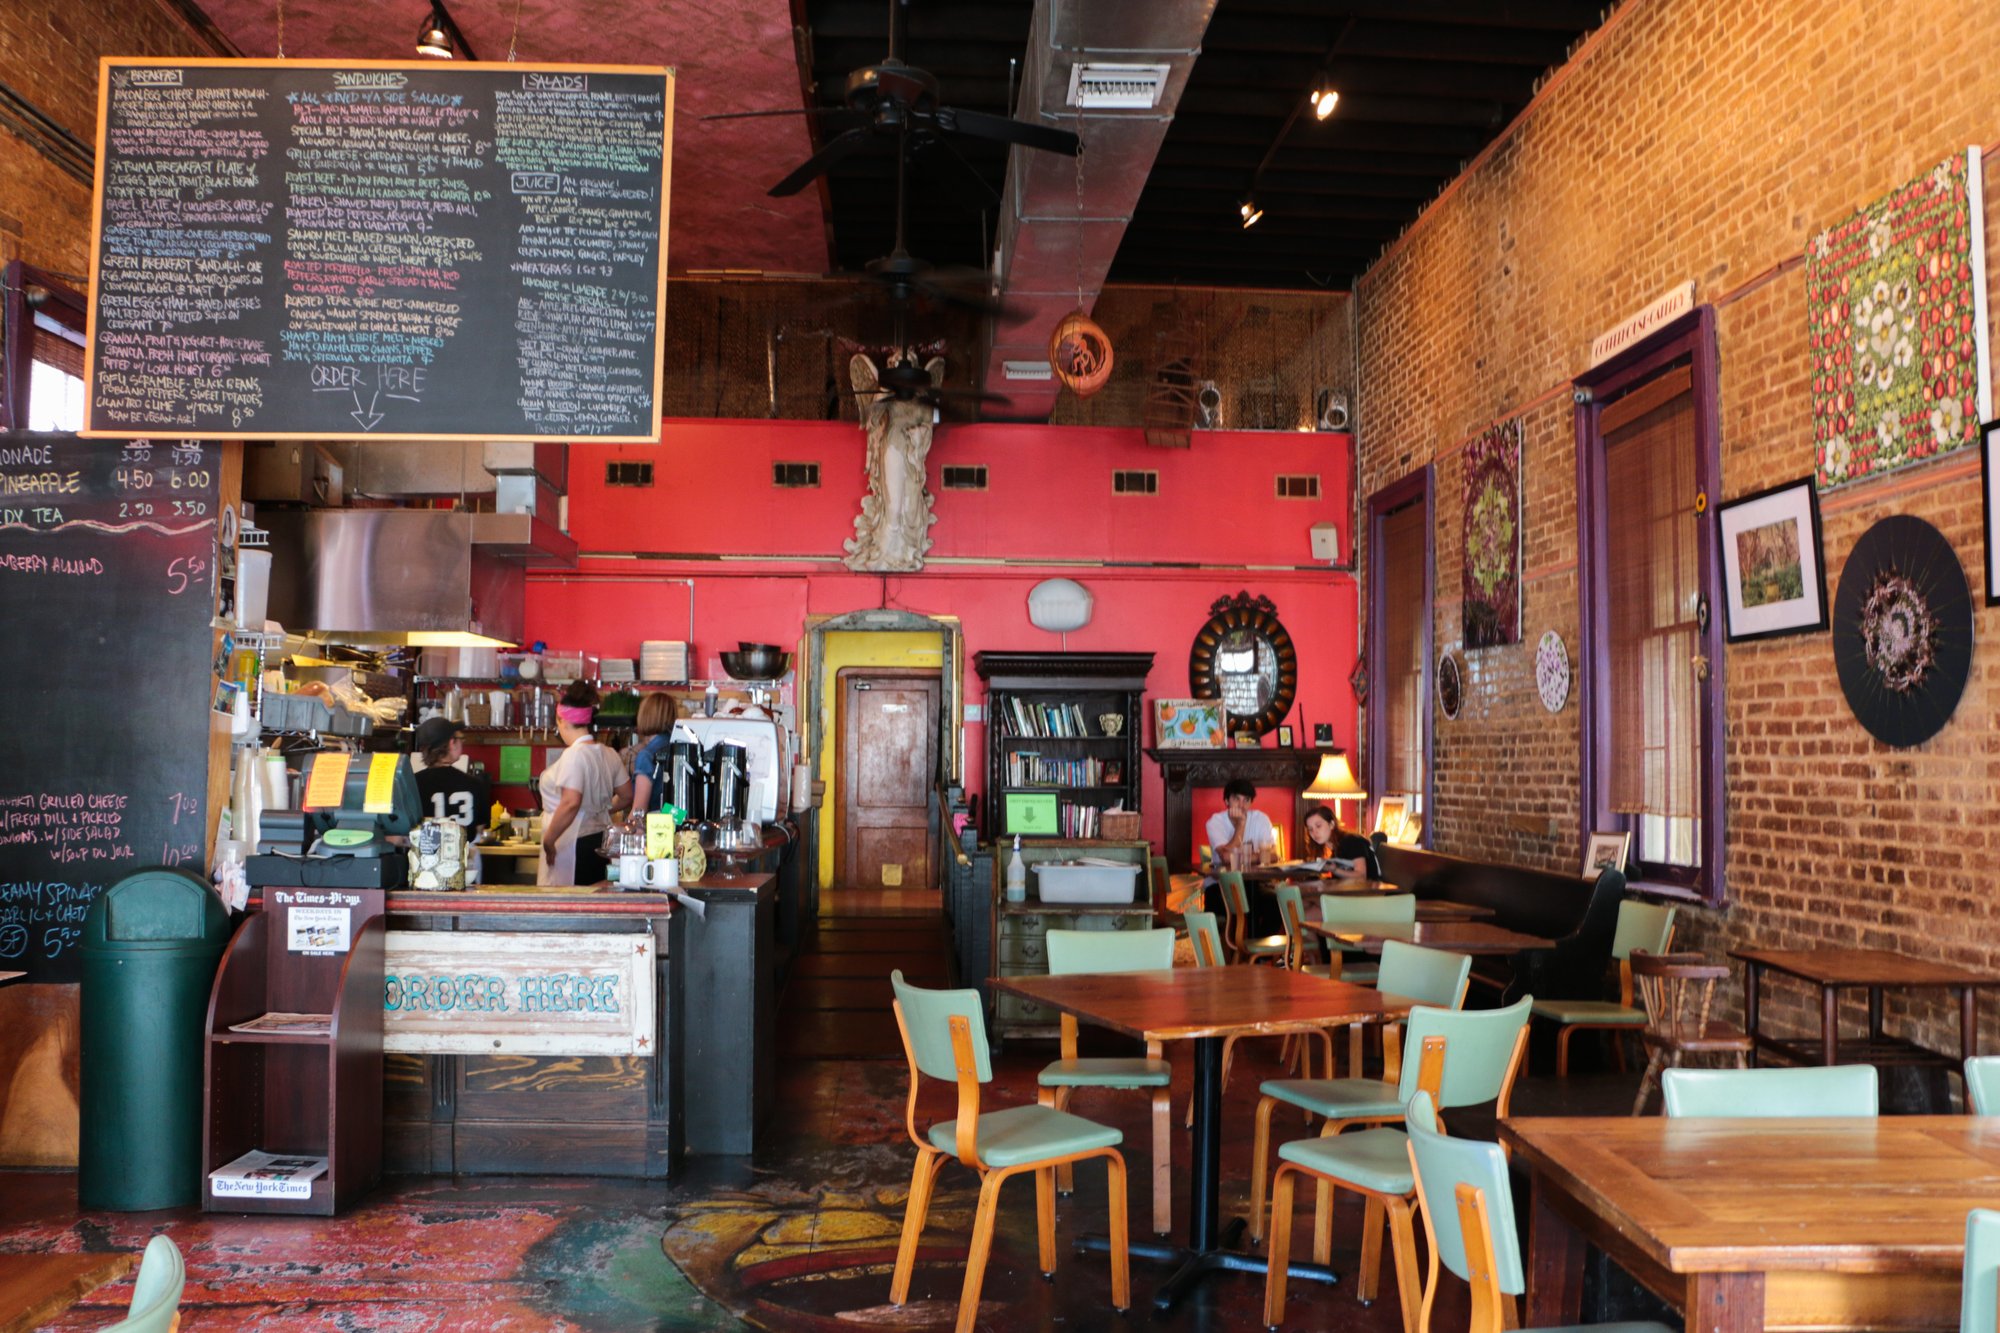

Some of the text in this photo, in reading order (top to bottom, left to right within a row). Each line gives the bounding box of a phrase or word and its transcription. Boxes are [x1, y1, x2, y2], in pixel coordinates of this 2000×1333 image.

[332, 72, 409, 87] SANDWICHES
[528, 73, 584, 90] SALADS
[156, 161, 213, 174] BREAKFAST
[515, 176, 555, 190] JUICE
[103, 253, 140, 269] GREEN
[142, 255, 193, 272] BREAKFAST
[311, 363, 428, 393] ORDER HERE
[0, 445, 53, 466] ONADE
[117, 469, 153, 490] 4.50
[171, 470, 210, 489] 6.00
[32, 507, 64, 523] TEA
[39, 793, 85, 811] GRILLED
[88, 794, 128, 810] CHEESE
[430, 790, 475, 828] 13
[109, 844, 135, 861] JOUR
[0, 881, 102, 906] EAMY SPINAC
[275, 891, 294, 904] The
[384, 973, 620, 1014] ORDER HERE
[216, 1179, 308, 1195] The New York Times
